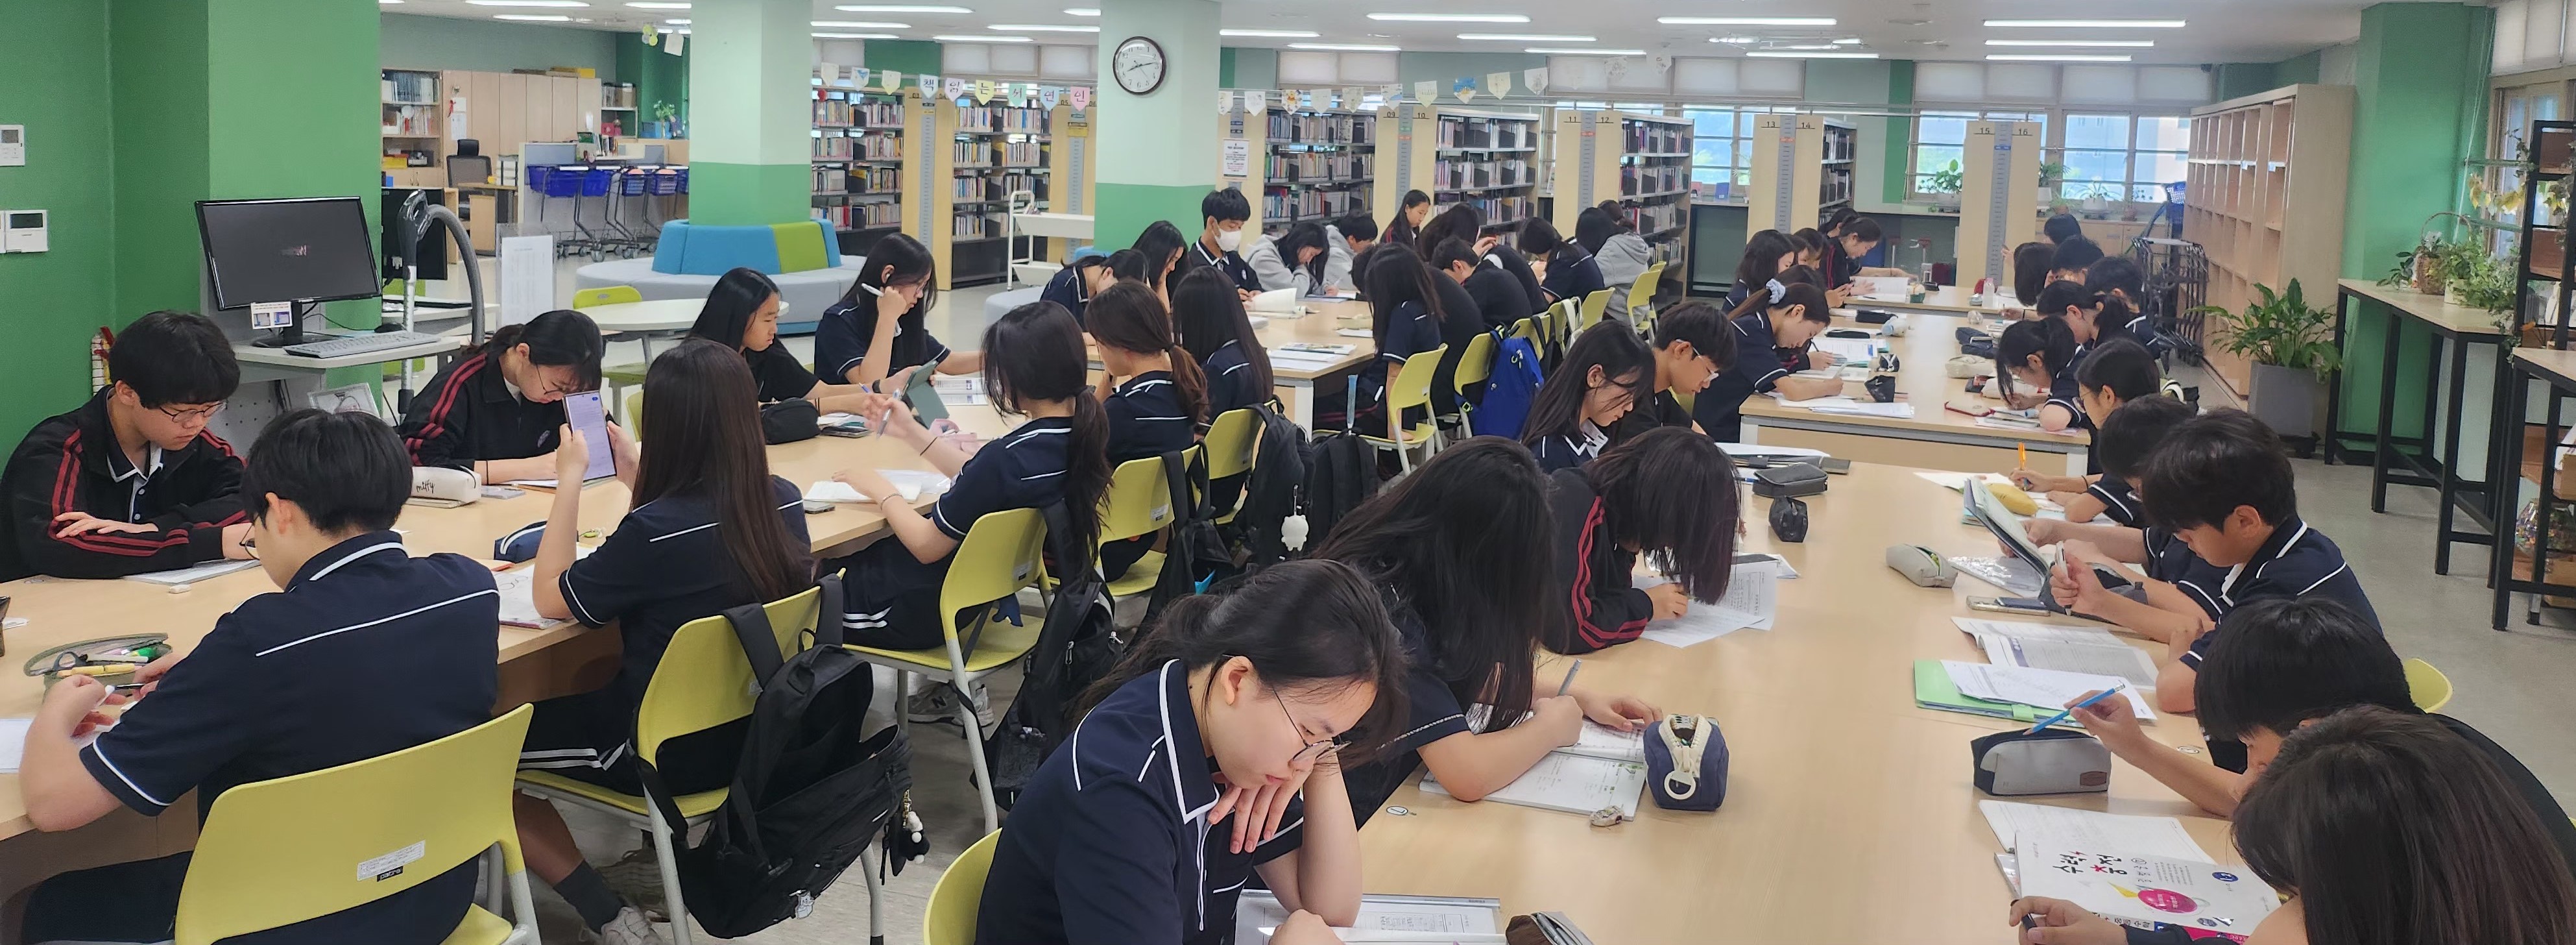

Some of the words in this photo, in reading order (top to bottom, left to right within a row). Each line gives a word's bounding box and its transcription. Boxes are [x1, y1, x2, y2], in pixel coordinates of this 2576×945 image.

[923, 79, 934, 91] 책
[416, 479, 435, 493] miffy
[2052, 853, 2088, 874] 수력
[2089, 853, 2128, 875] 충전
